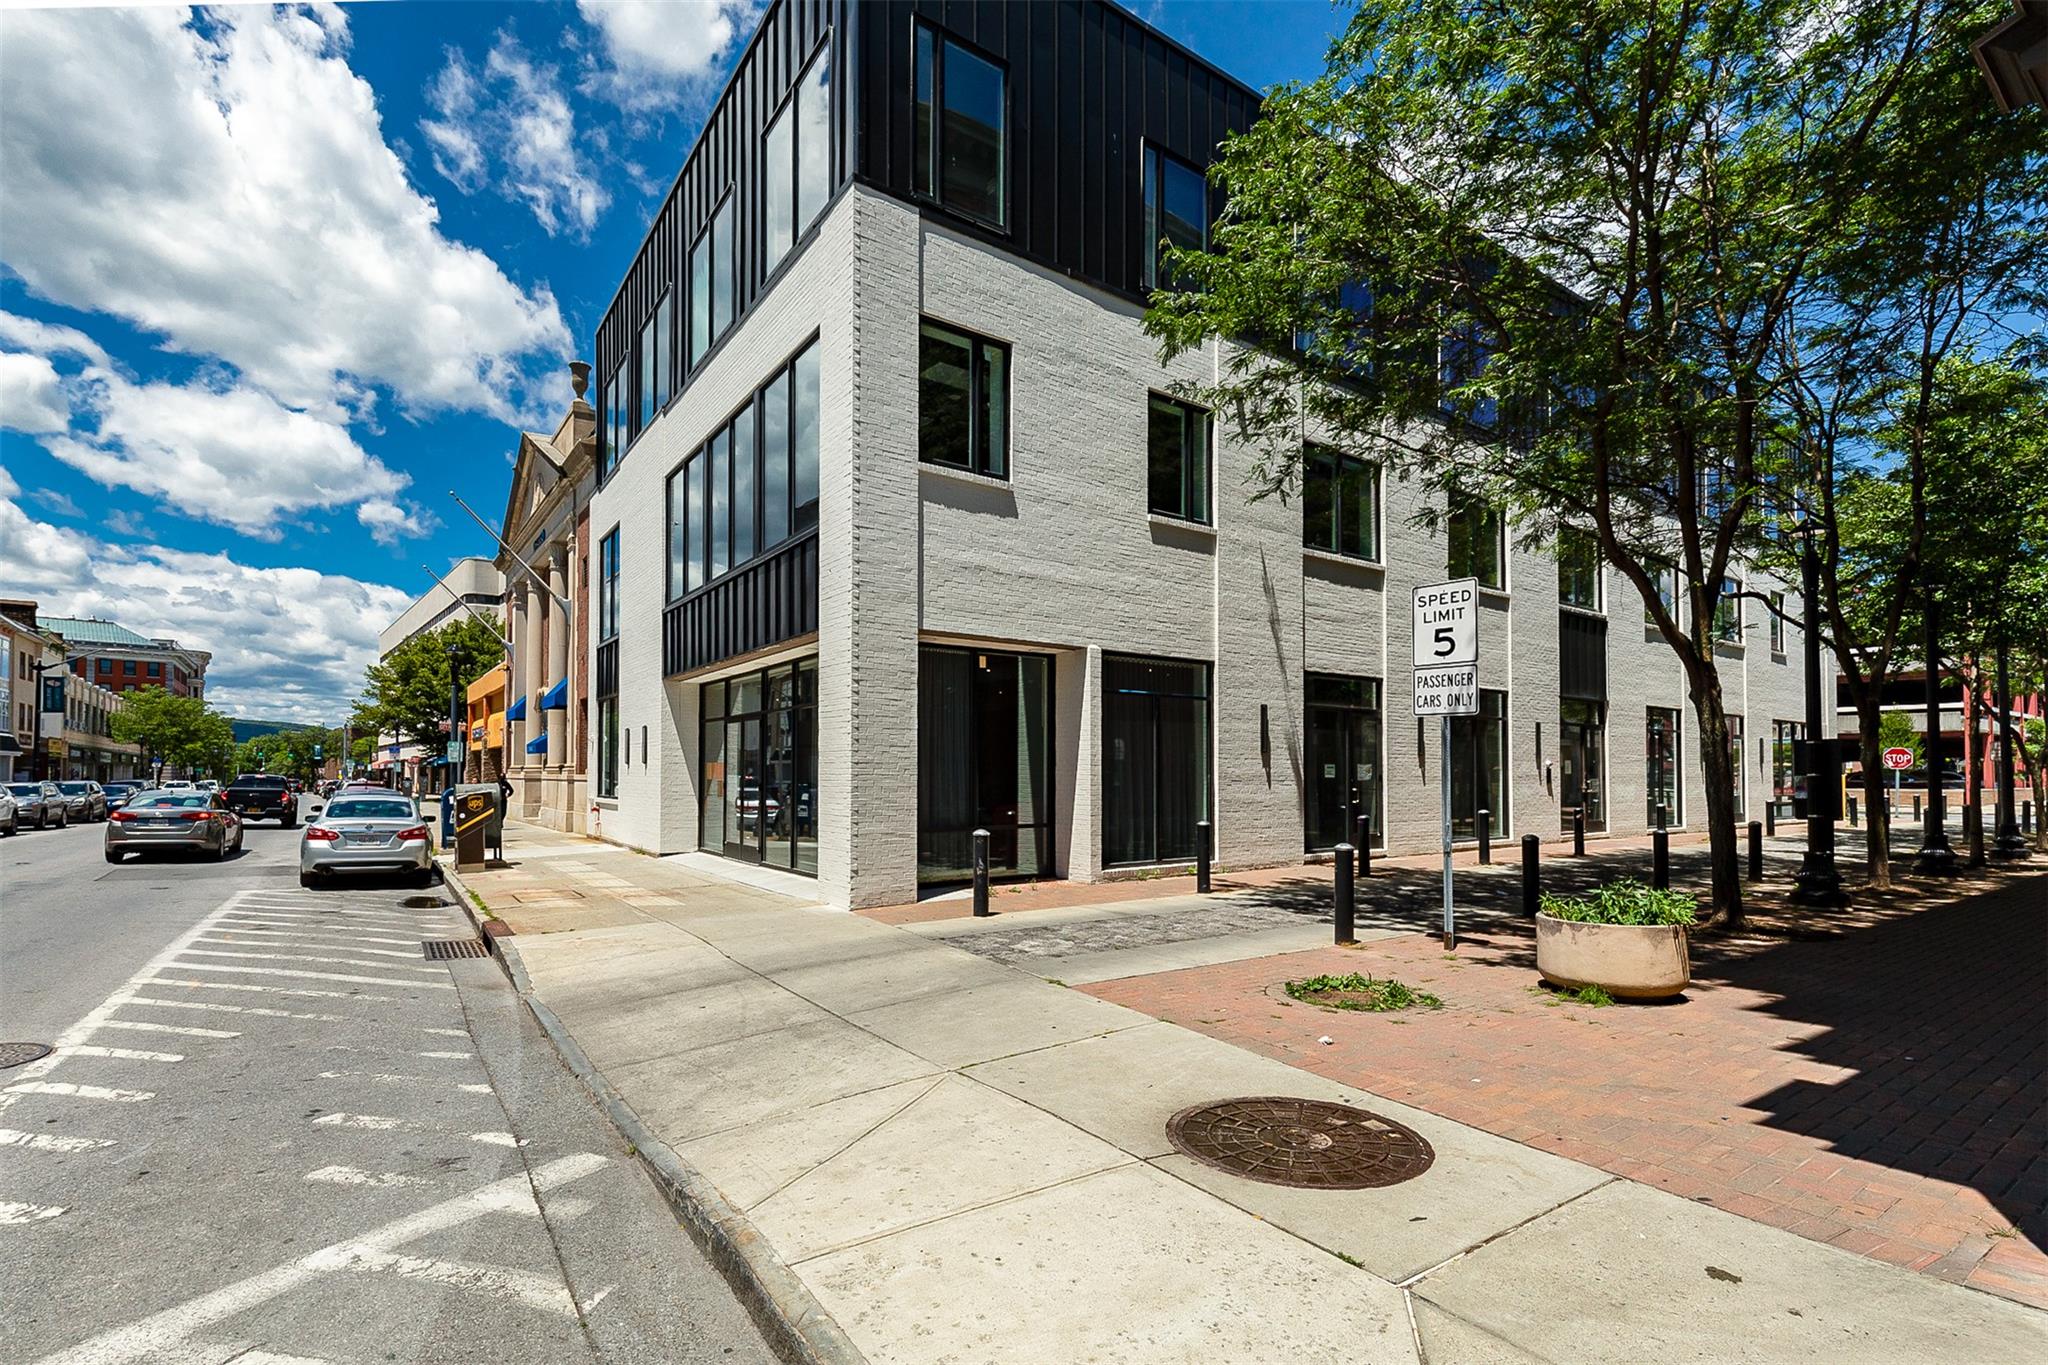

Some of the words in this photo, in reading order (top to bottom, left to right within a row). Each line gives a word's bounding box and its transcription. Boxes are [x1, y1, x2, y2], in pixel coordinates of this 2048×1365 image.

[1418, 590, 1471, 607] SPEED
[1424, 607, 1465, 623] LIMIT
[1434, 627, 1456, 657] 5
[1417, 673, 1473, 688] PASSENGER
[1416, 694, 1441, 708] CARS
[1447, 692, 1474, 706] ONLY
[1885, 754, 1911, 763] STOP
